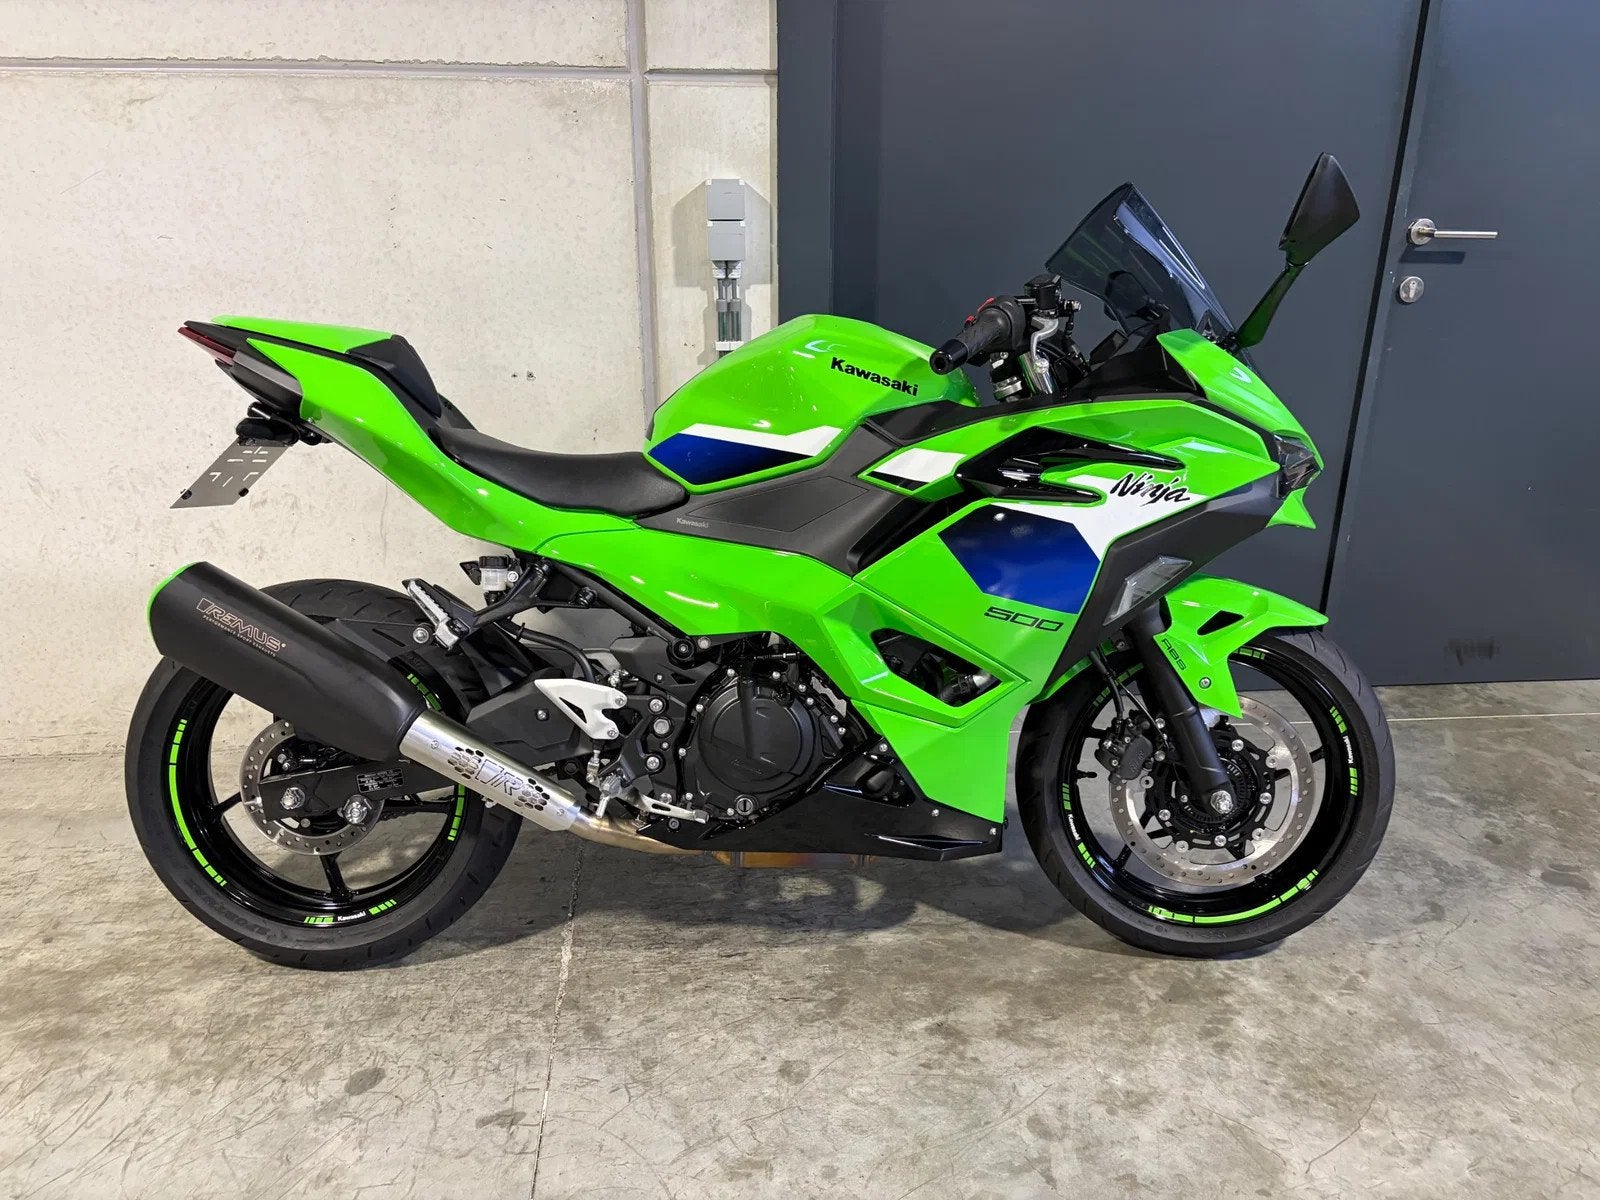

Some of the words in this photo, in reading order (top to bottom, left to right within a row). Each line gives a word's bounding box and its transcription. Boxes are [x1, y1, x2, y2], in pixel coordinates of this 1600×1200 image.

[831, 356, 918, 397] Kawasaki
[1110, 472, 1190, 507] Ninja
[676, 517, 709, 528] Kawasaki
[203, 602, 281, 652] REMUS
[984, 606, 1064, 632] 500
[1161, 638, 1187, 671] ABS
[337, 910, 367, 922] Kawasaki
